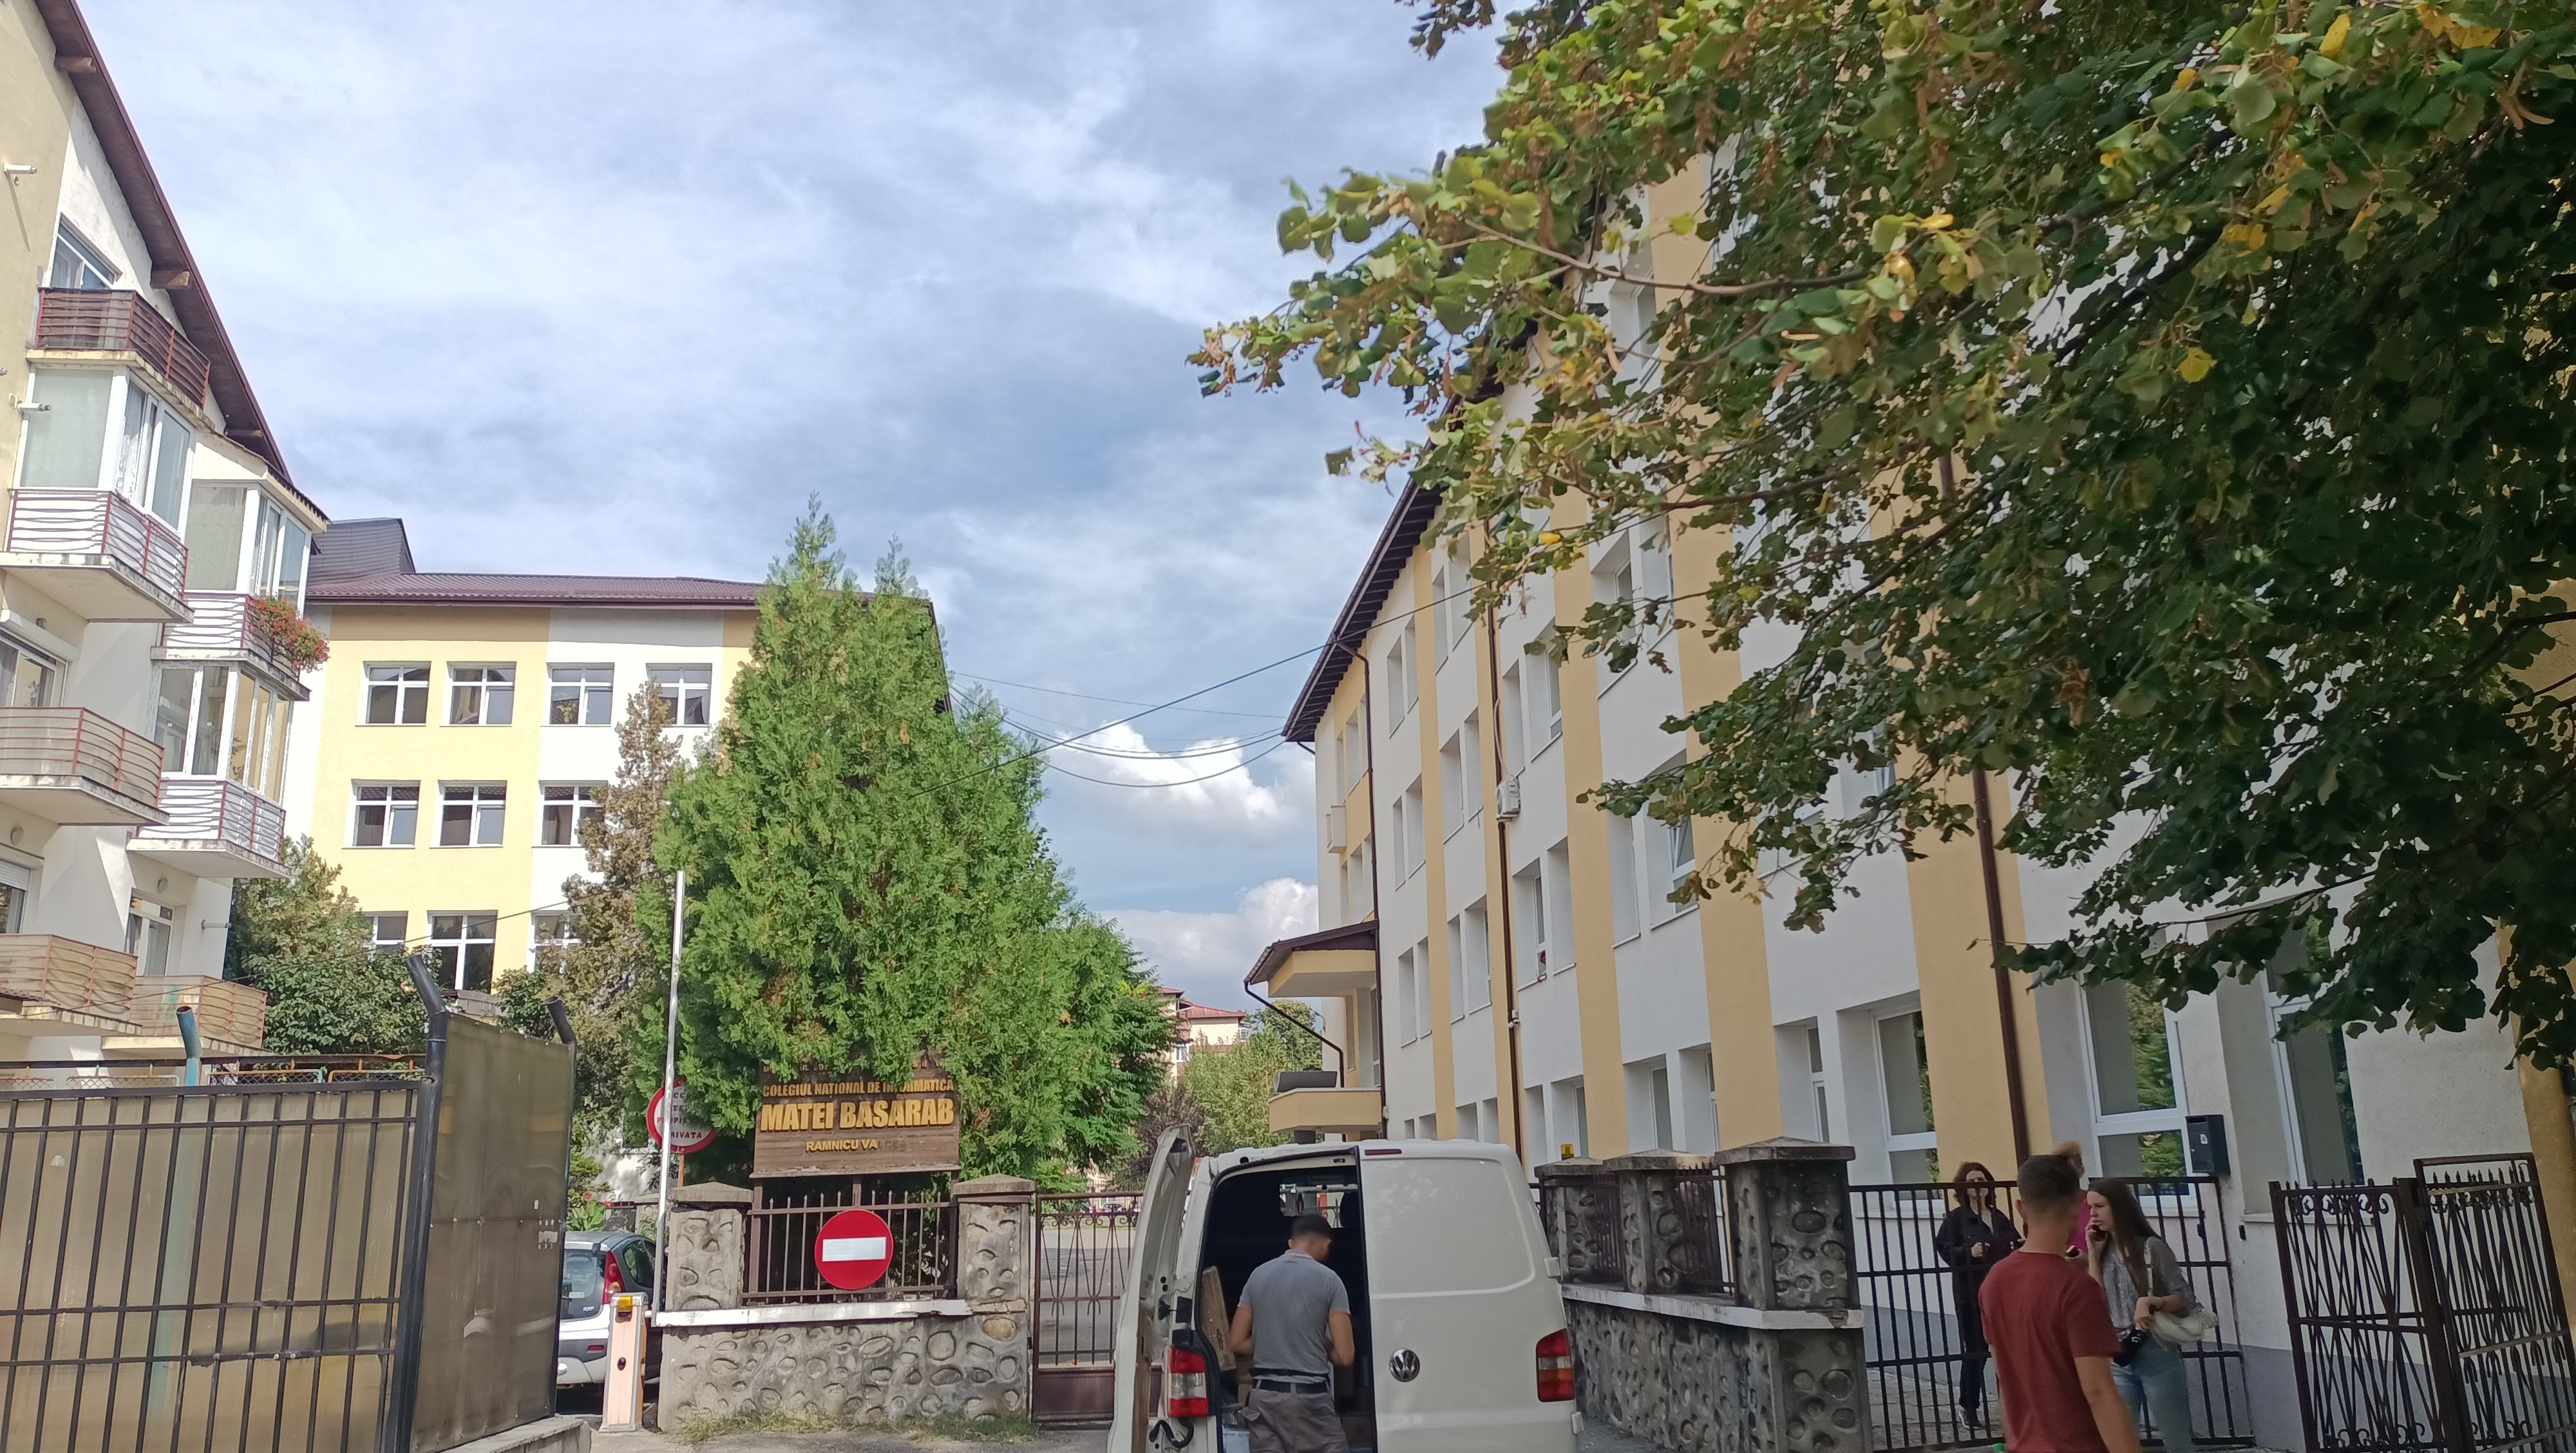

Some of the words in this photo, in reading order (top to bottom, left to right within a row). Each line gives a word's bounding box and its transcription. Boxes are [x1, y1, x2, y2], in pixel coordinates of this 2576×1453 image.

[762, 1083, 812, 1097] COLEGIUL
[867, 1081, 880, 1094] DE
[760, 1102, 834, 1131] MATEI
[839, 1097, 954, 1128] BASARAB
[806, 1139, 859, 1152] RAMNICU
